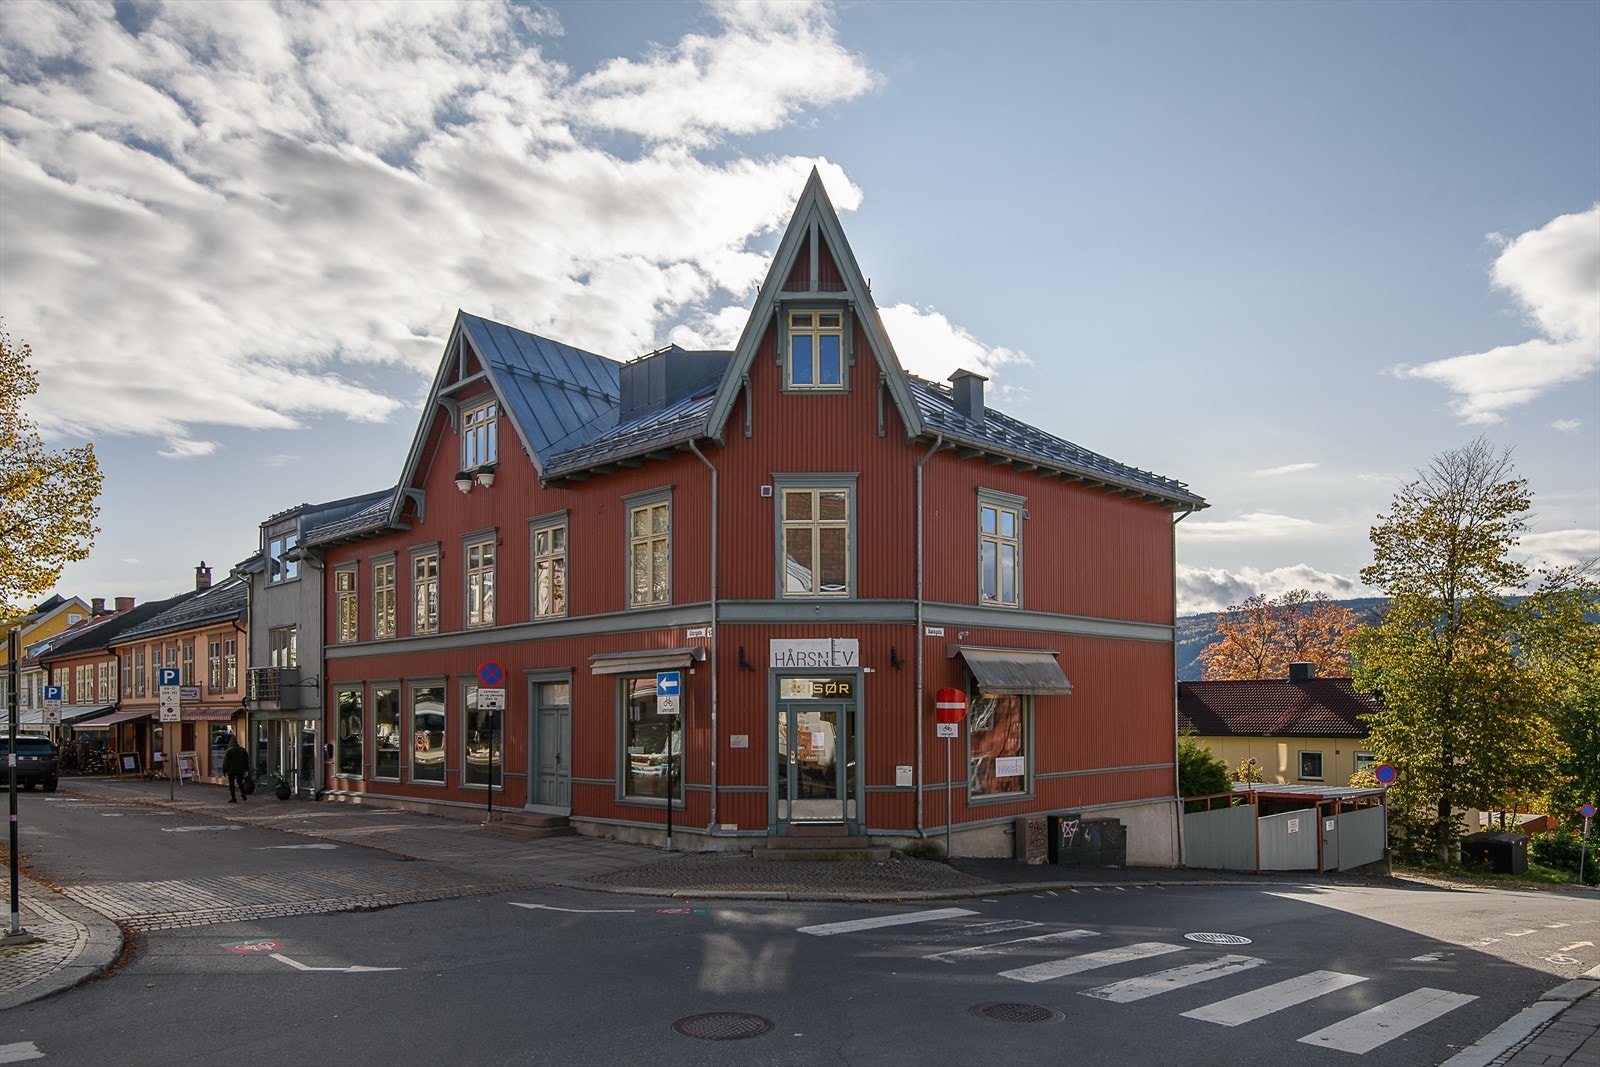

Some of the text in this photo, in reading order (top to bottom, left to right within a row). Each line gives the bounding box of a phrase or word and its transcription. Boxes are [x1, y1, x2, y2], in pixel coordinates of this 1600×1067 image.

[774, 639, 854, 667] HÅRSNEV
[164, 670, 176, 684] P
[48, 687, 57, 698] P
[783, 682, 850, 695] FRISØR
